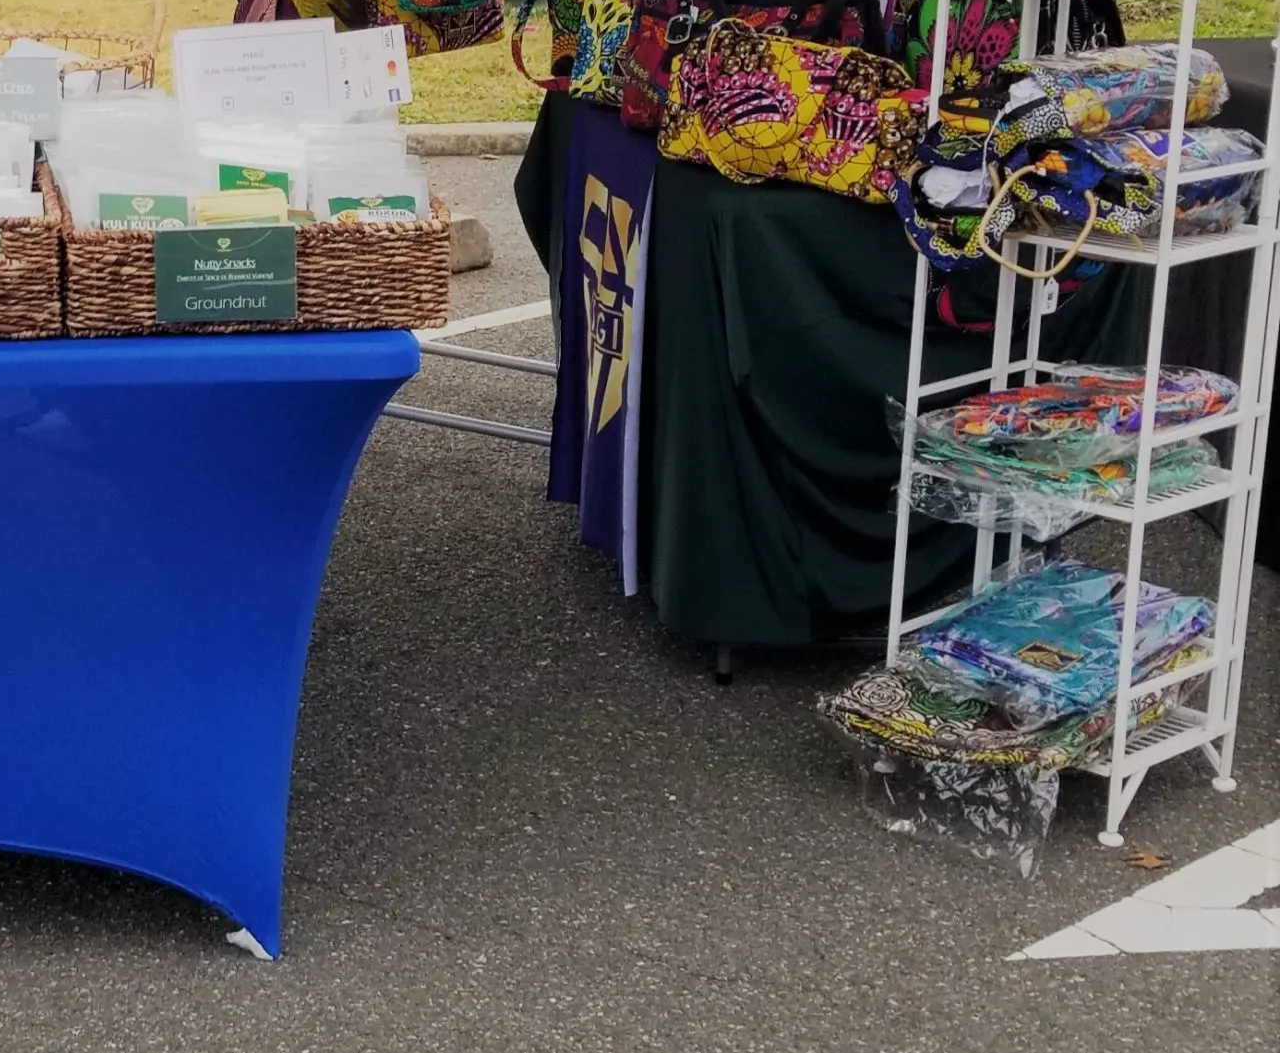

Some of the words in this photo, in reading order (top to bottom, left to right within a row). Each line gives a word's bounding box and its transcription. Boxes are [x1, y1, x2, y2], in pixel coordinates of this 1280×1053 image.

[194, 259, 222, 272] Nutty
[223, 258, 257, 269] Snacks
[185, 295, 268, 311] Groundnut
